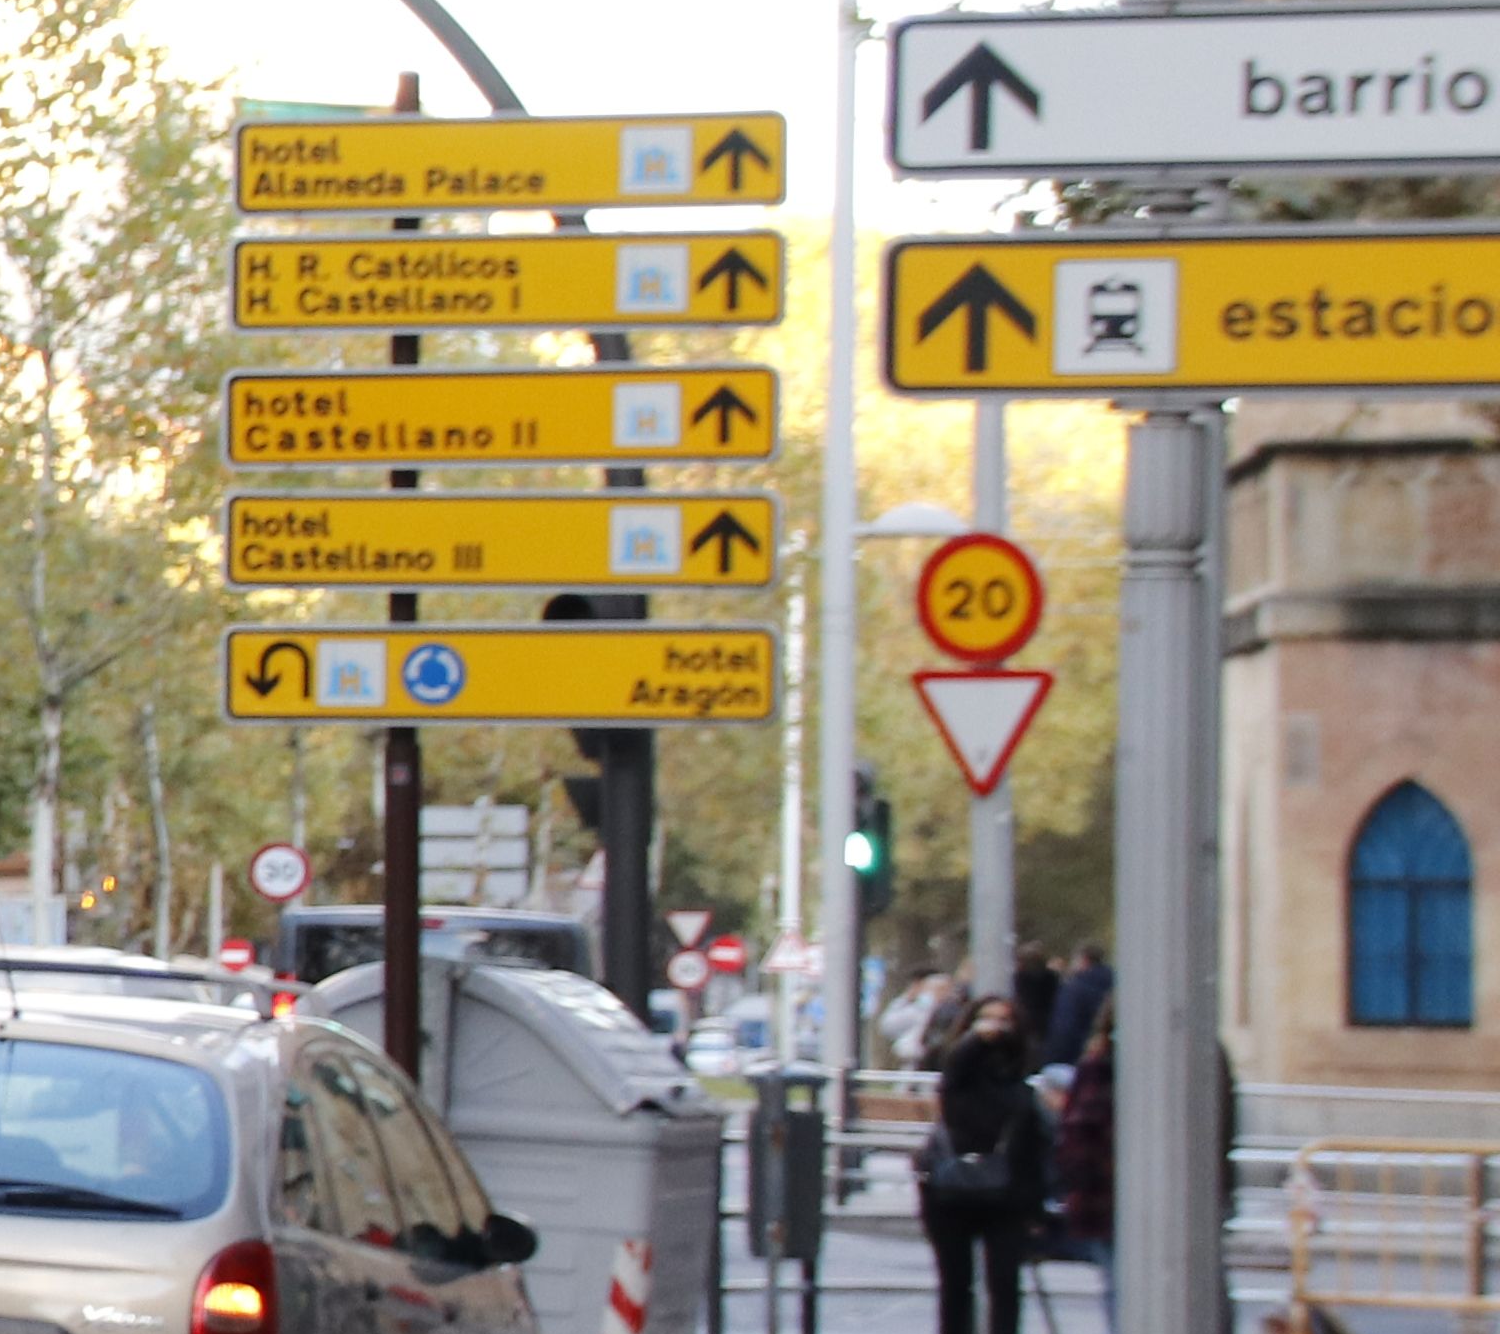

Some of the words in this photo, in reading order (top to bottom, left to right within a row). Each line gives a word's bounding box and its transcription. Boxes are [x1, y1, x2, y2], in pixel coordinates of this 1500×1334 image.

[1243, 56, 1490, 116] barrio
[252, 137, 340, 164] hotel
[254, 169, 405, 197] Alameda
[427, 167, 544, 194] Palace
[349, 252, 520, 280] Católicos
[298, 286, 495, 314] Castellano
[244, 390, 347, 416] hotel
[245, 422, 493, 451] Castellano
[512, 420, 538, 448] II
[242, 511, 330, 538] hotel
[242, 543, 435, 571] Castellano
[453, 543, 484, 571] III
[945, 579, 1015, 620] 20
[665, 643, 757, 672] hotel
